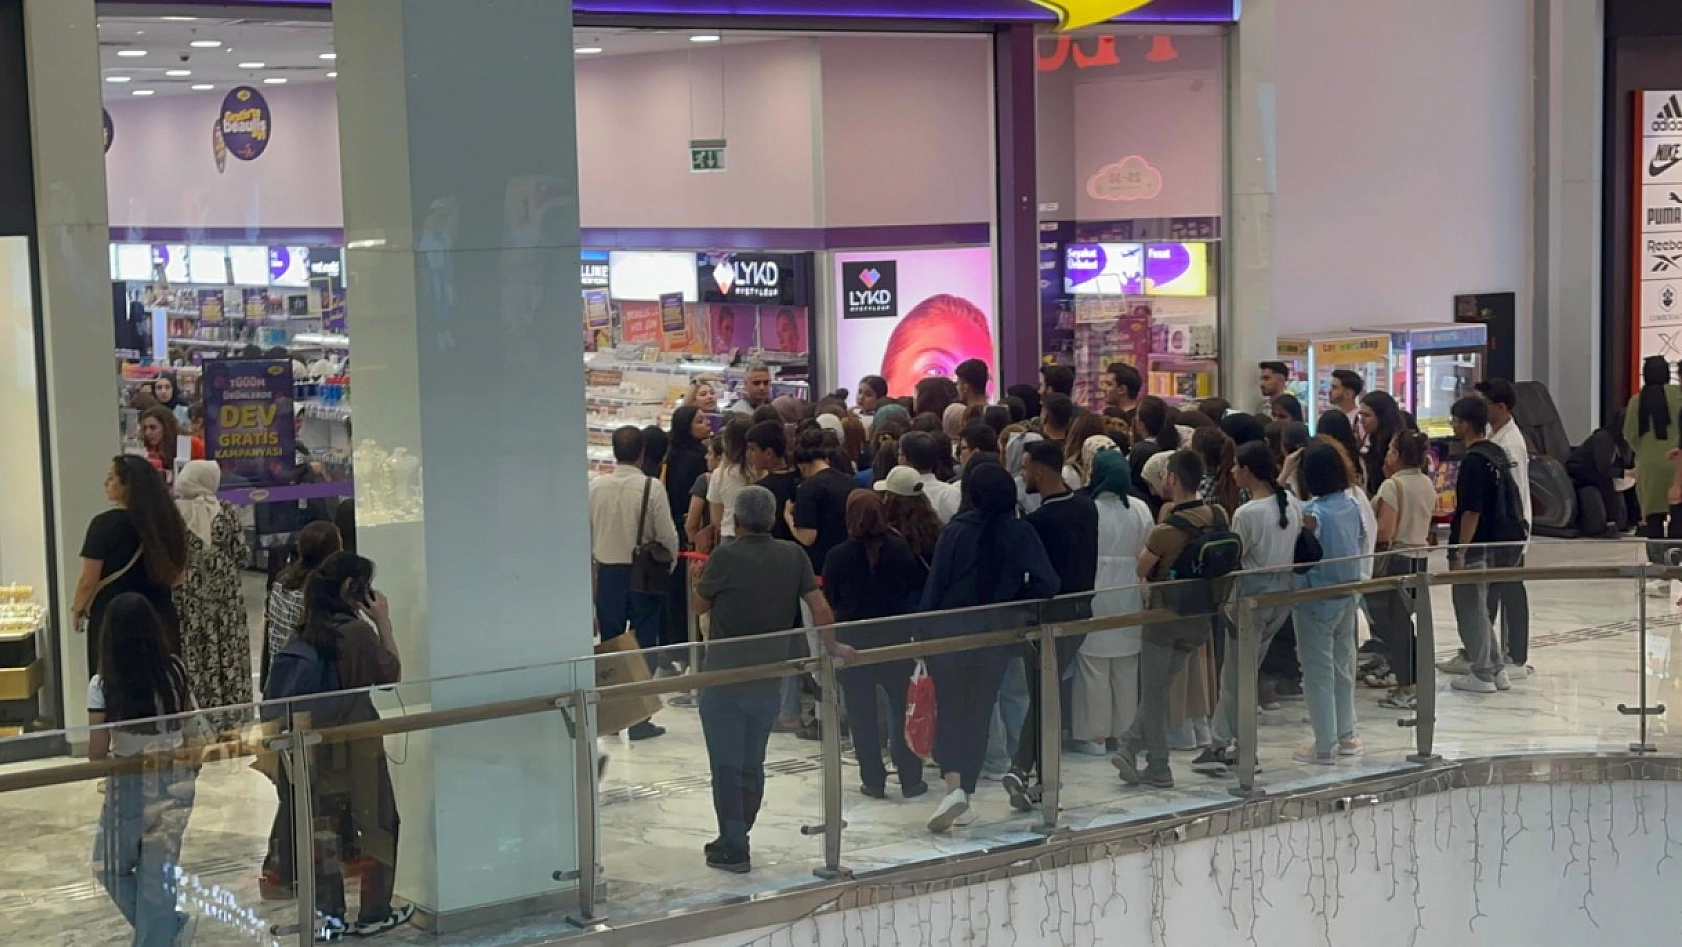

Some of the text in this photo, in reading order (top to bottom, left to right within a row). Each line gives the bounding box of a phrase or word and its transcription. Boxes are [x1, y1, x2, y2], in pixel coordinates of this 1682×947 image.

[1656, 144, 1681, 160] NIKE
[1647, 207, 1681, 225] PUMA
[734, 260, 779, 286] LYKD
[849, 289, 892, 305] LYKD
[221, 404, 277, 428] DEV
[220, 429, 279, 446] GRATİS
[215, 447, 282, 458] KAMPANYASI
